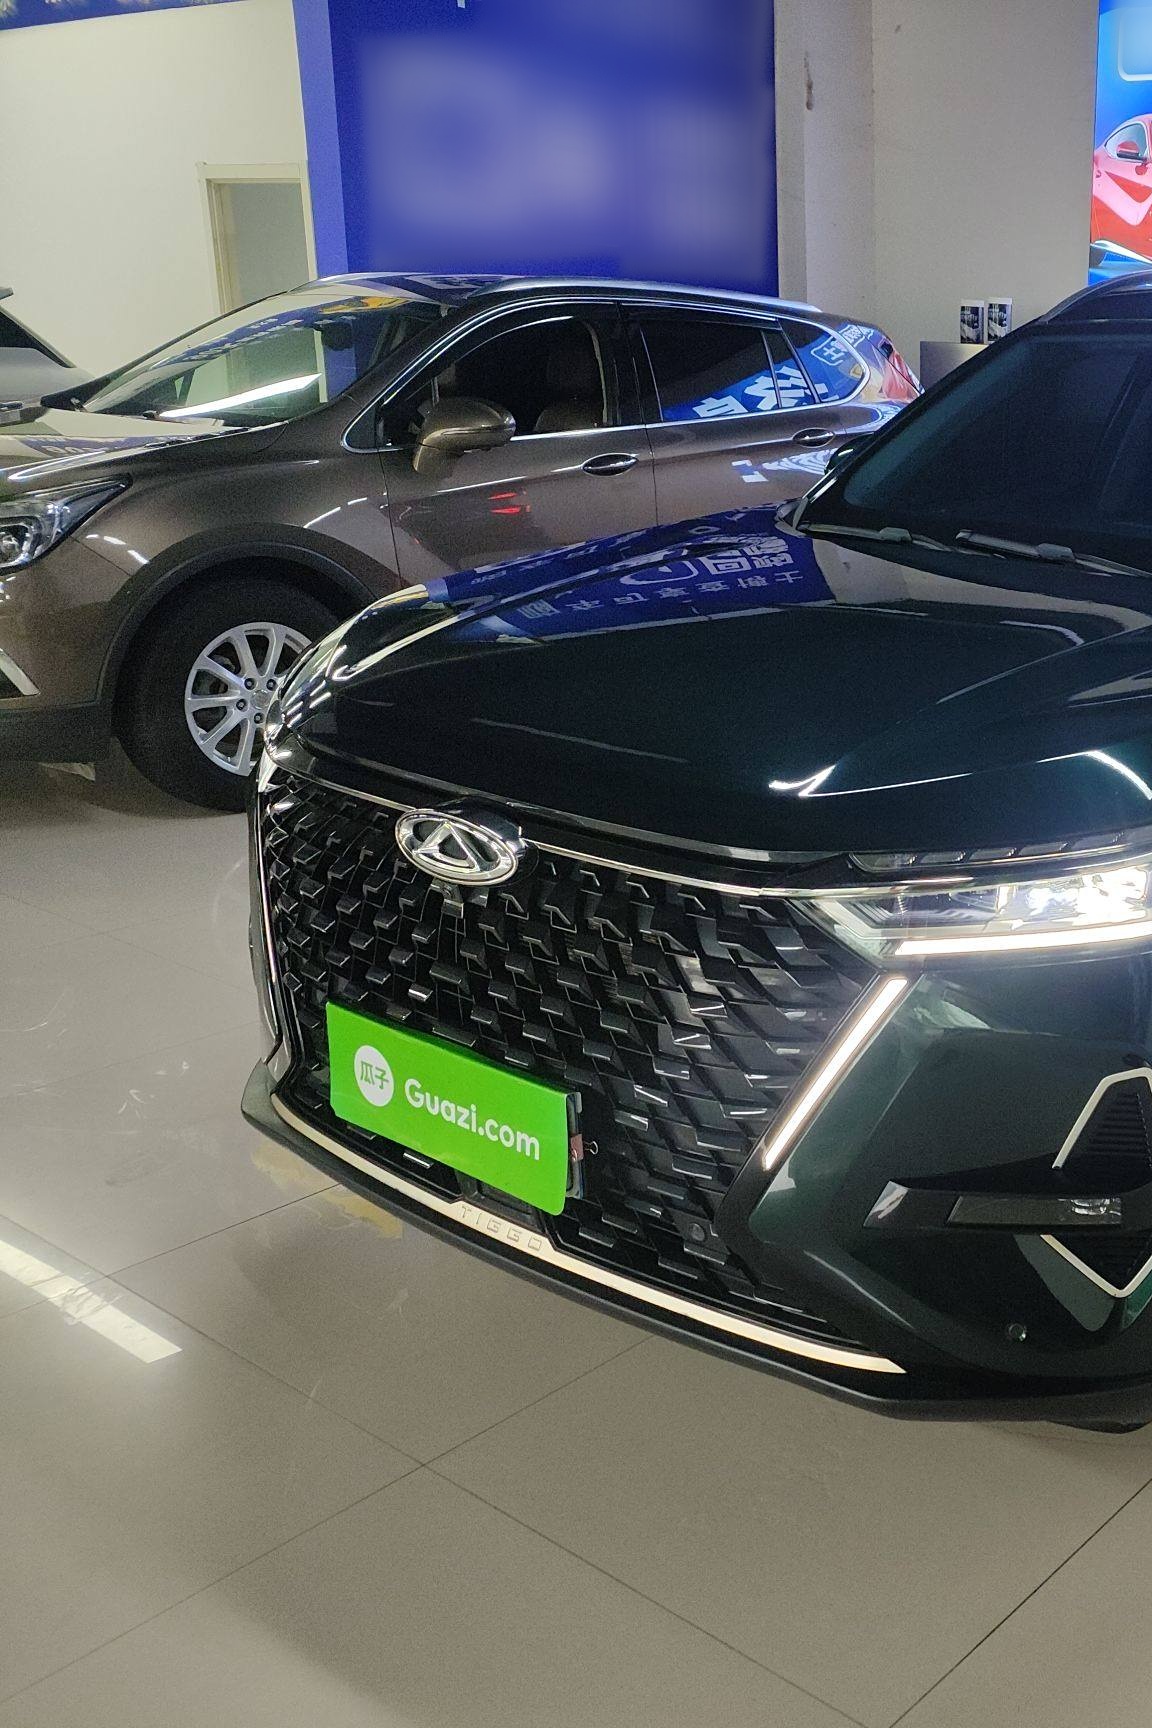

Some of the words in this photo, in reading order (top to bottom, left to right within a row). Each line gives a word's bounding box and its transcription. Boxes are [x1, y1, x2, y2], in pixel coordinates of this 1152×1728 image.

[360, 1060, 389, 1090] 瓜子
[404, 1078, 540, 1161] Guazi.com
[459, 1205, 543, 1251] TIGGO
